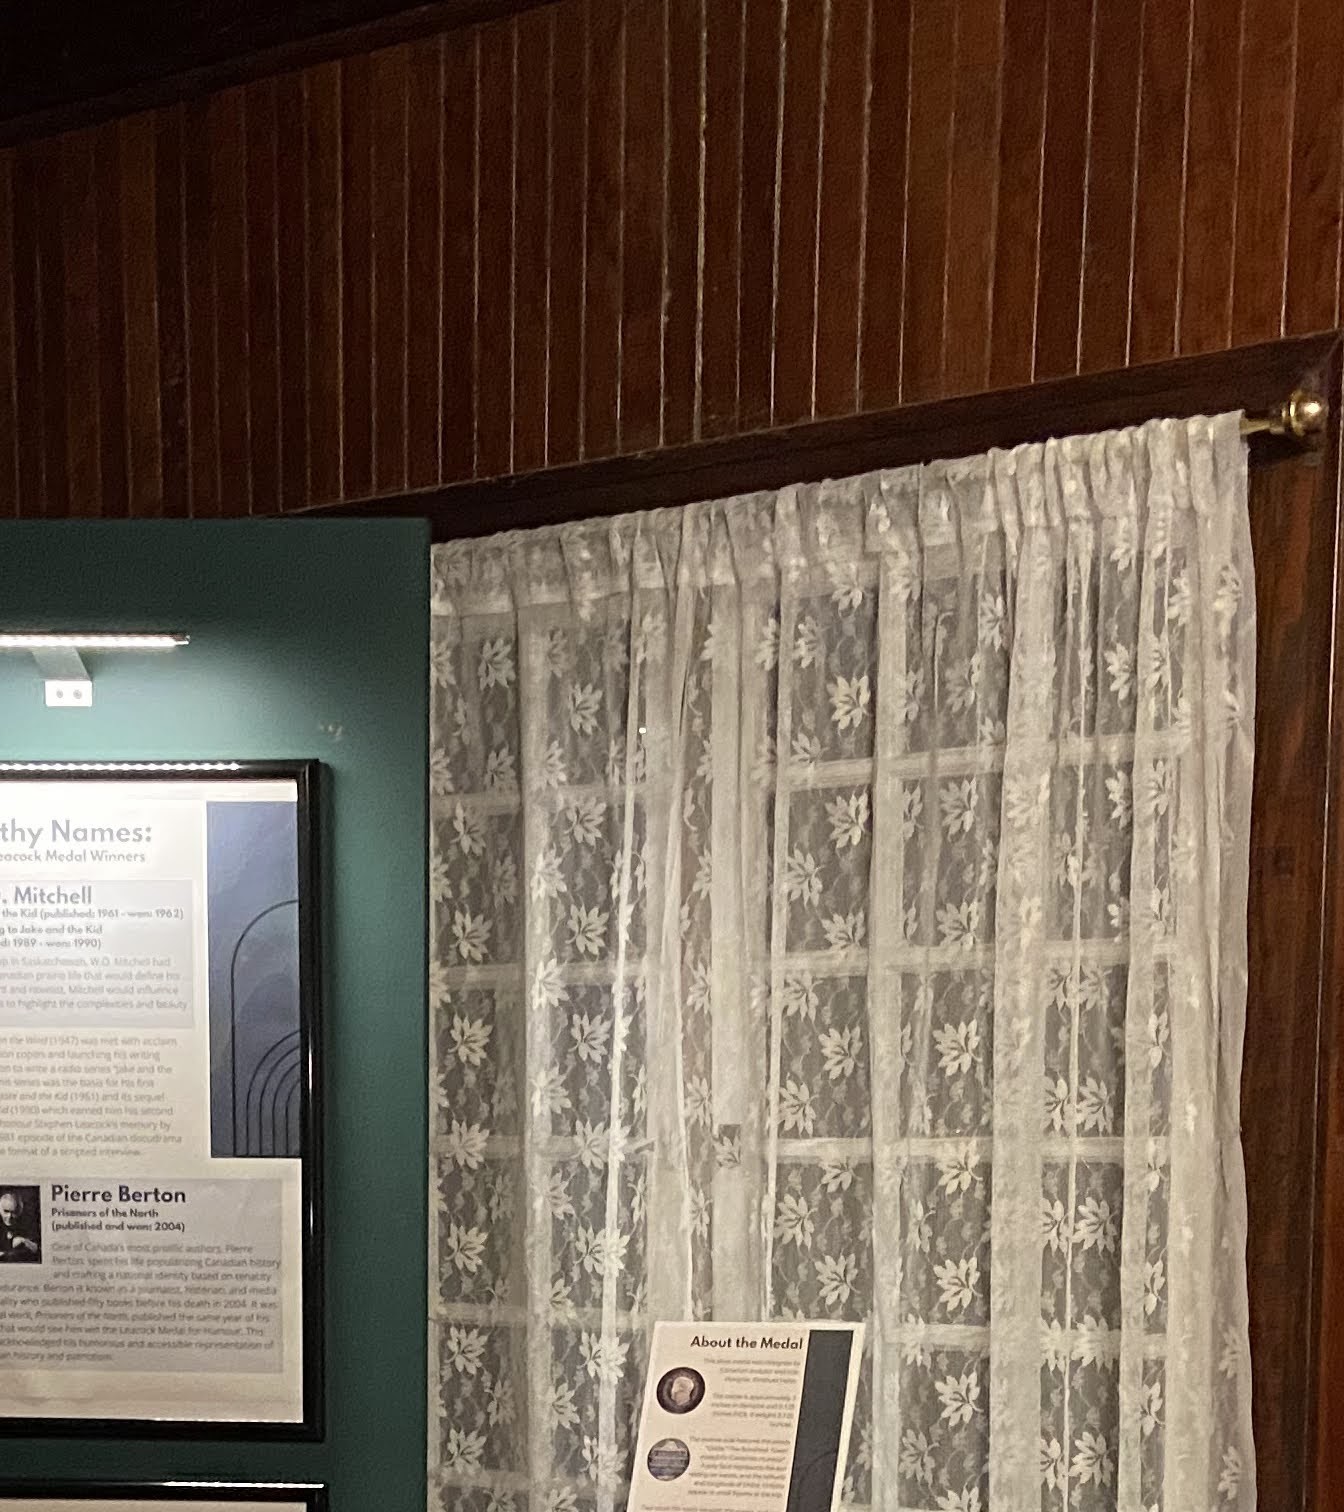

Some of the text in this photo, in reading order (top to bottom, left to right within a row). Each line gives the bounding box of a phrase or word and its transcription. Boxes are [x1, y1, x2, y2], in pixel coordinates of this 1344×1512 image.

[51, 820, 153, 843] Names:
[45, 849, 87, 862] Medal
[90, 850, 145, 862] Winners
[14, 886, 91, 904] Mitchell
[52, 1184, 186, 1203] Pierre Berton
[690, 1336, 804, 1350] About the Medal
